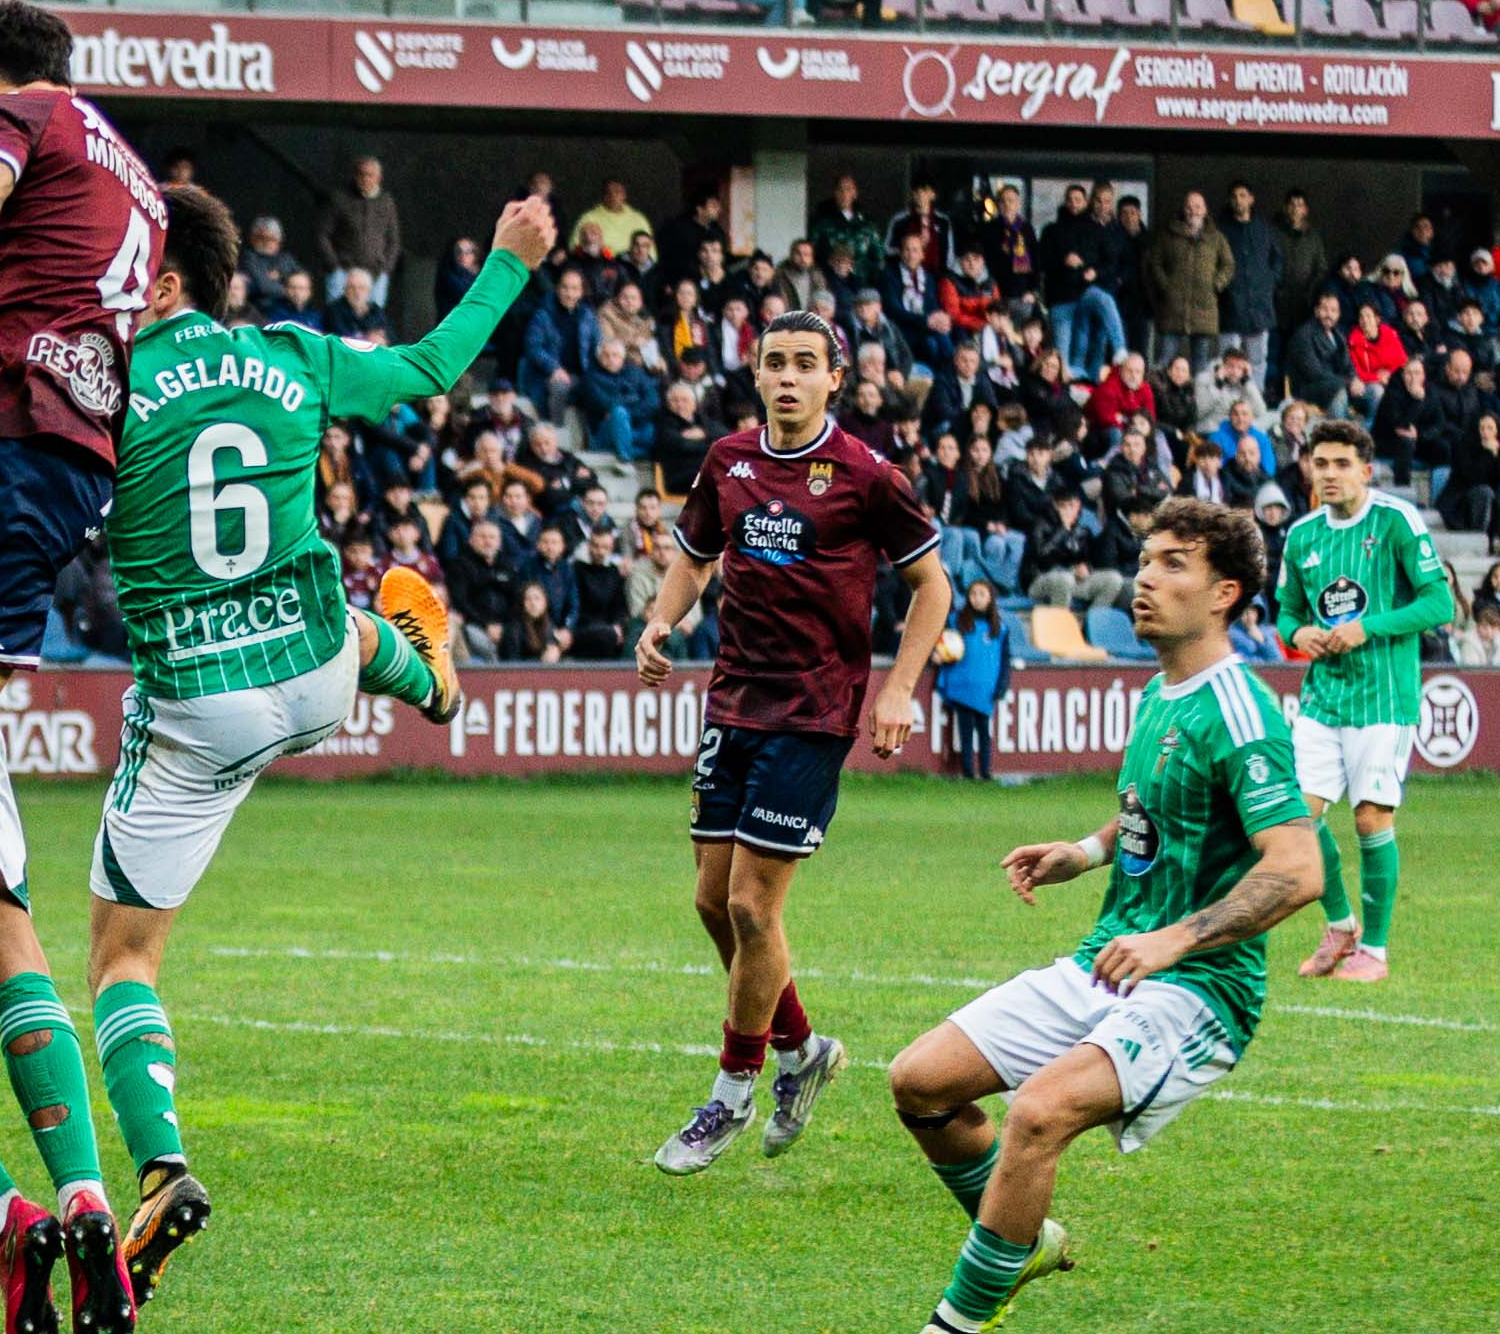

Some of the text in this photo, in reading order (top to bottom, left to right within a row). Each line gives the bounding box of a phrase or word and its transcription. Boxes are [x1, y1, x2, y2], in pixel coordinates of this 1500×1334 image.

[73, 22, 275, 93] ntevedra
[963, 46, 1131, 121] sergraf
[1134, 54, 1409, 97] SERIGRAFÍA IMPRENTA ROTULACIÓN
[1155, 94, 1389, 126] www.sergrafpontevedra.com
[129, 168, 169, 231] BOSC
[96, 206, 151, 343] 4
[129, 354, 305, 423] A.GELARDO
[188, 422, 270, 580] 6
[743, 514, 803, 535] Estrella
[744, 530, 799, 552] Galicia
[164, 587, 304, 651] Prace
[494, 681, 699, 757] FEDERACIÓ
[752, 807, 809, 830] ABANCA
